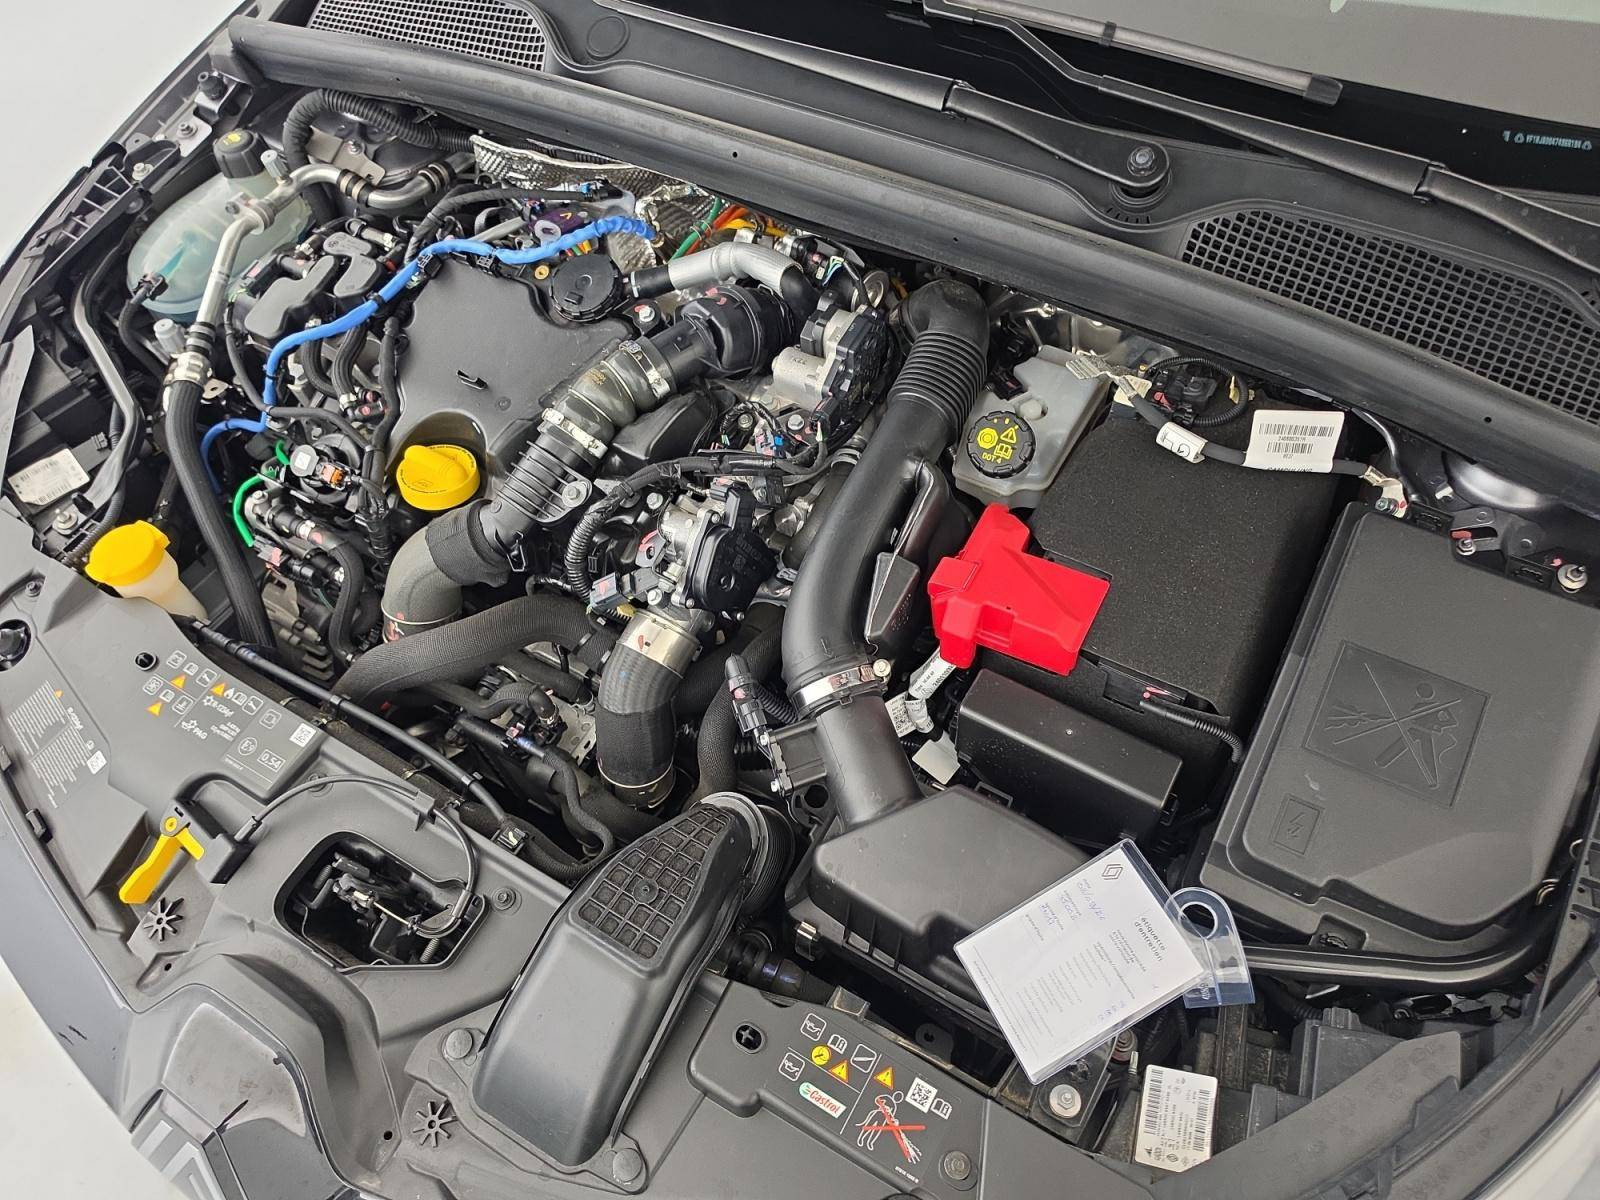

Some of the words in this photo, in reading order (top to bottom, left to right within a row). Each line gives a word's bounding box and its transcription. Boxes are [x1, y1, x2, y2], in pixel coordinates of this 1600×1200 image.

[982, 452, 996, 462] DOT
[193, 727, 208, 740] PAG
[808, 1088, 841, 1114] Castrol
